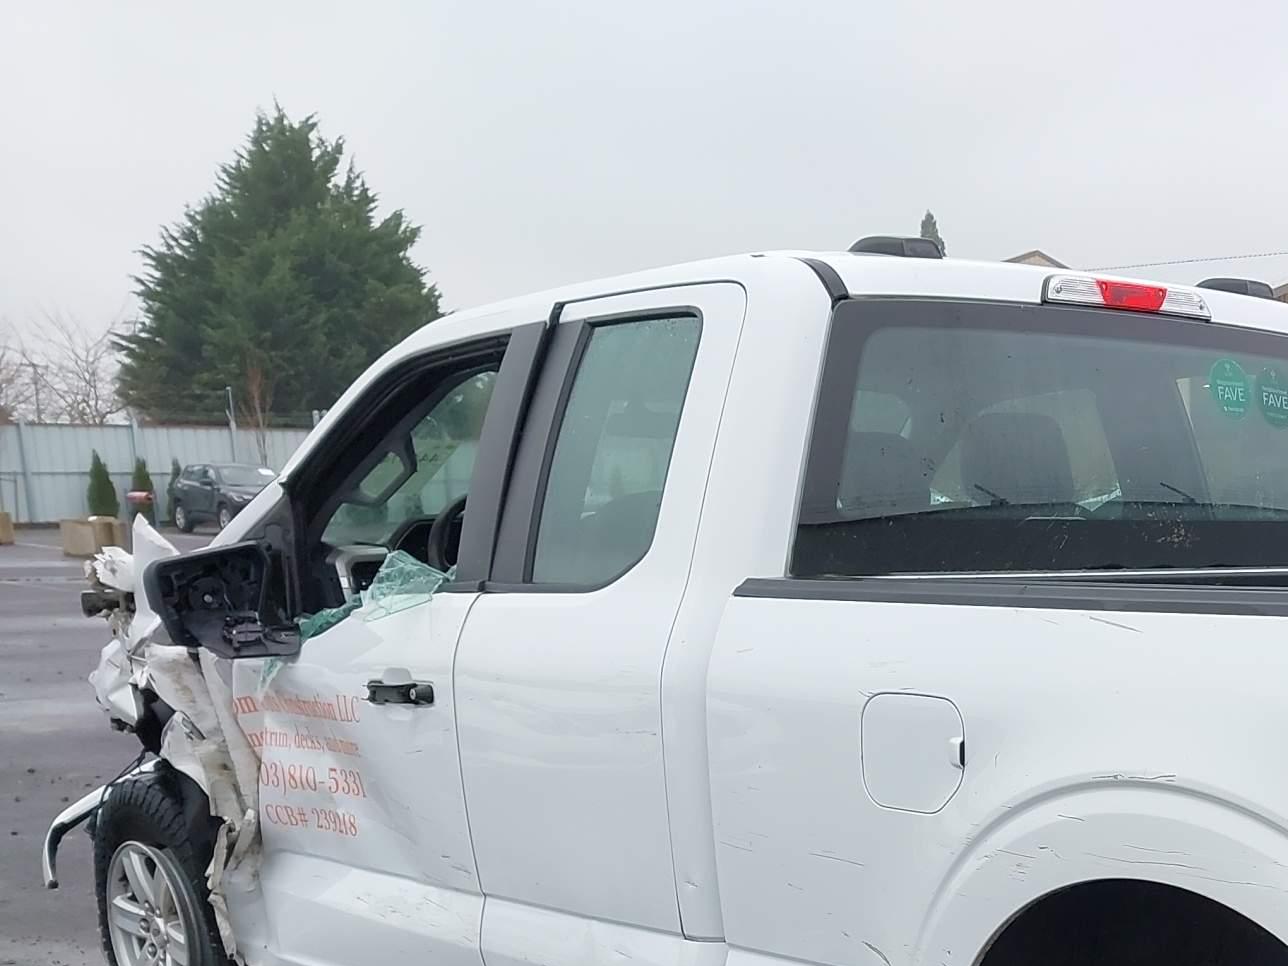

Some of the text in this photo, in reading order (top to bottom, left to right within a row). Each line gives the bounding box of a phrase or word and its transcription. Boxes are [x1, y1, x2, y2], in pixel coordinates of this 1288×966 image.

[1217, 385, 1246, 402] FAVE
[1262, 392, 1288, 410] FAVE
[336, 694, 361, 723] LLC
[260, 760, 367, 798] 03)810-5331
[264, 803, 309, 828] CCB#
